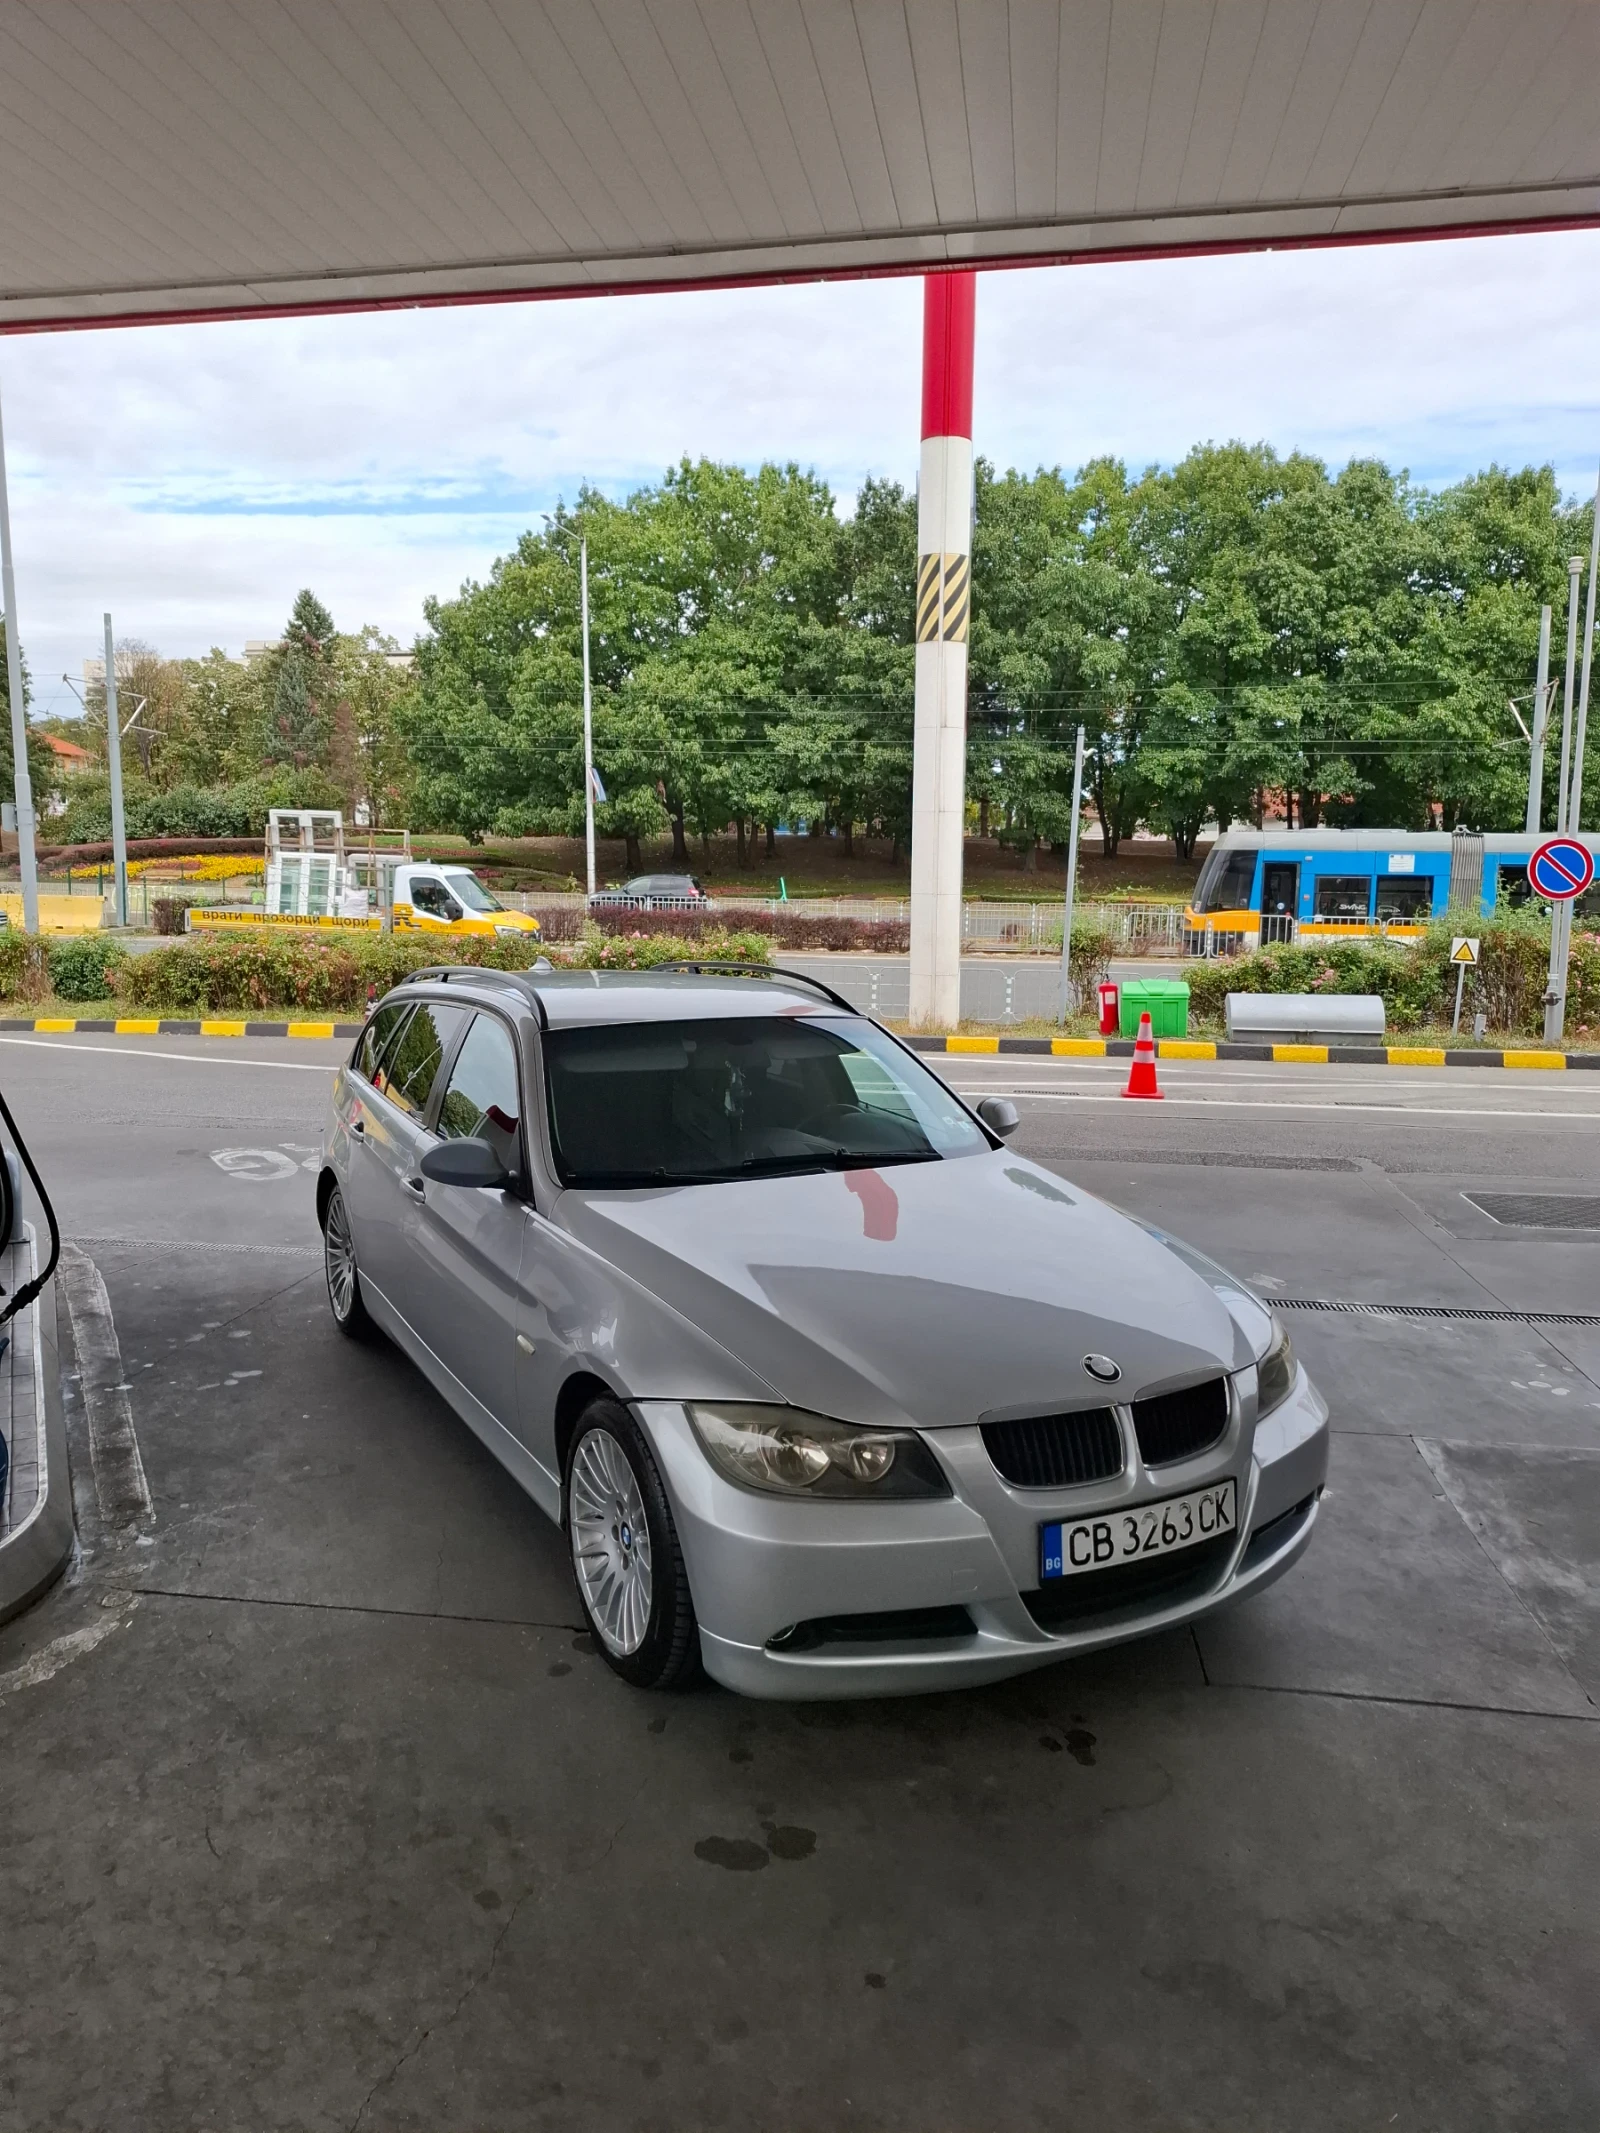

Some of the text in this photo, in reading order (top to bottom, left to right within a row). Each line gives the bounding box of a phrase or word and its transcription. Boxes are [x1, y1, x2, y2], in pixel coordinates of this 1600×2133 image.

[202, 911, 369, 928] врати прозорци щори
[1069, 1487, 1230, 1566] CB 3263 CK
[1045, 1557, 1061, 1571] BG
